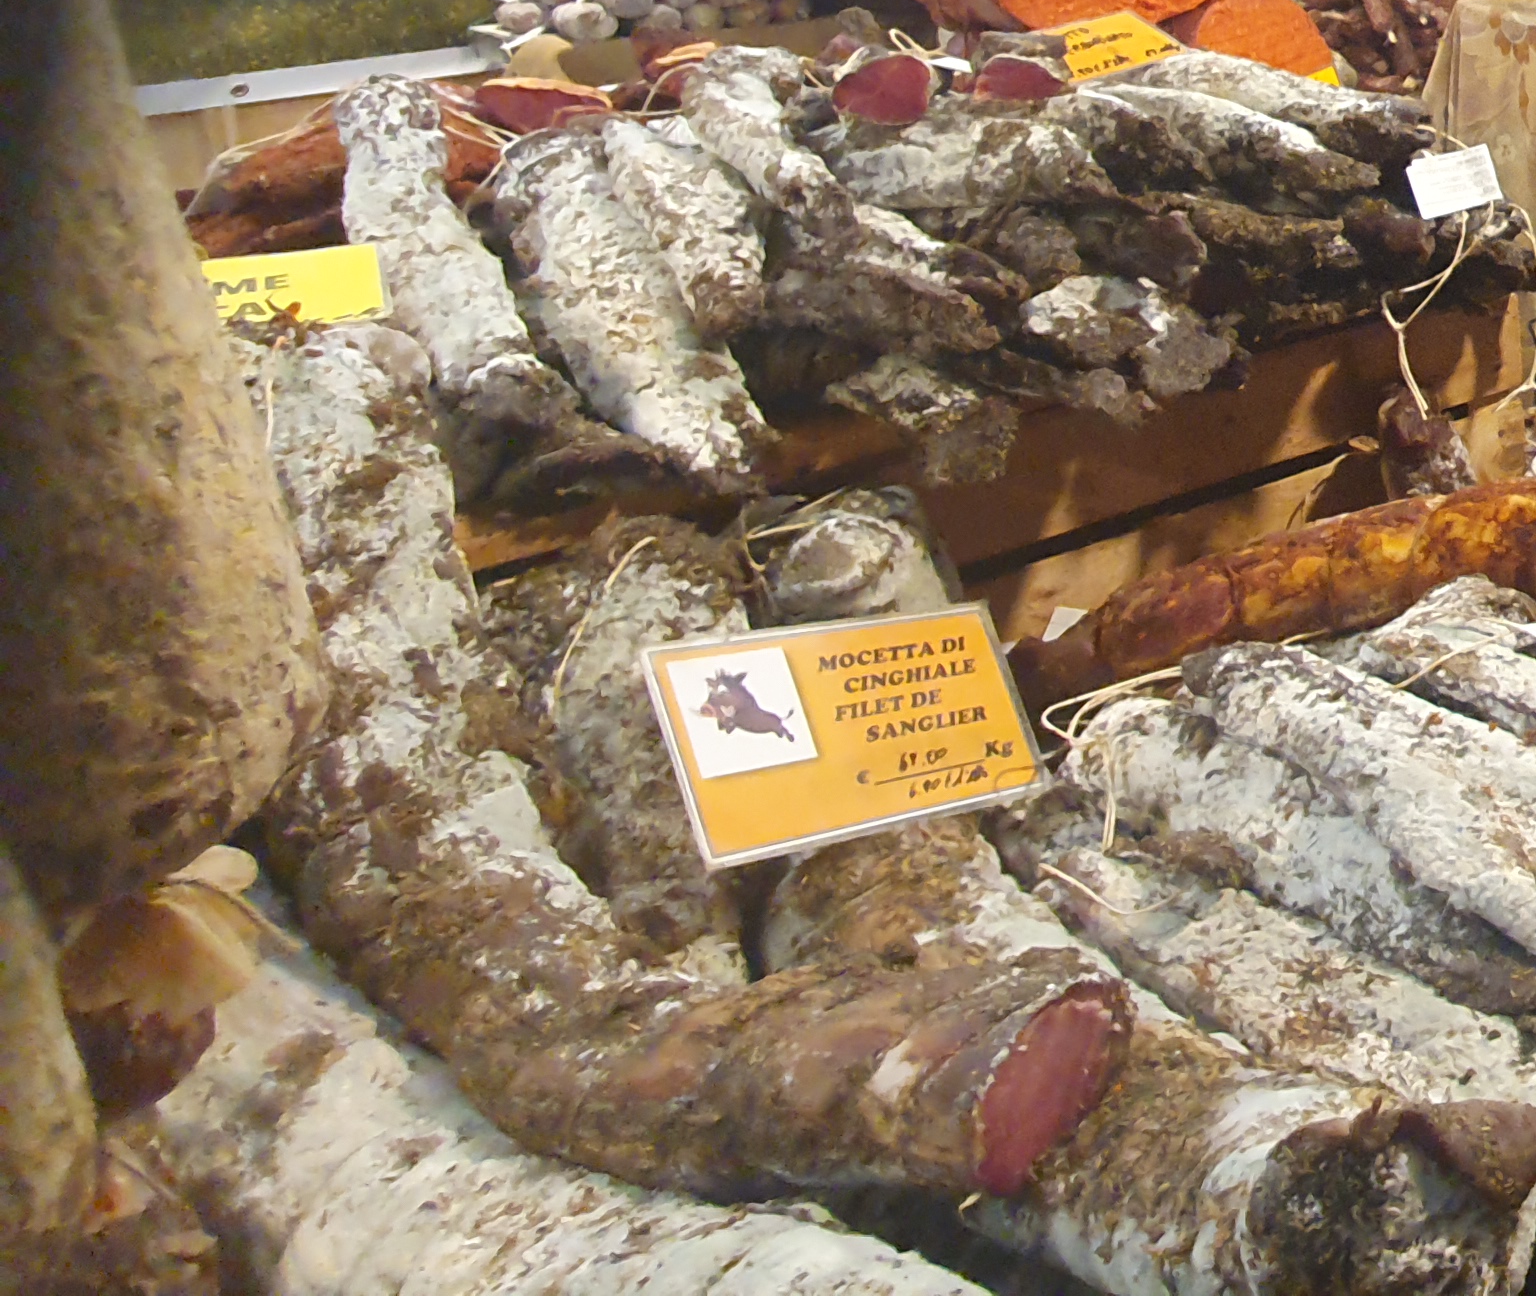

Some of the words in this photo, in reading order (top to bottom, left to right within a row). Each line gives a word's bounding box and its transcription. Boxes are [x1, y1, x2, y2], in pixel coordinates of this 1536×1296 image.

[213, 273, 290, 296] ME
[818, 641, 935, 673] MOCETTA
[941, 636, 966, 654] DI
[844, 658, 977, 694] CINGHIALE
[835, 694, 904, 722] FILET
[911, 688, 942, 708] DE
[866, 705, 988, 743] SANGLIER
[985, 740, 1014, 758] Kg
